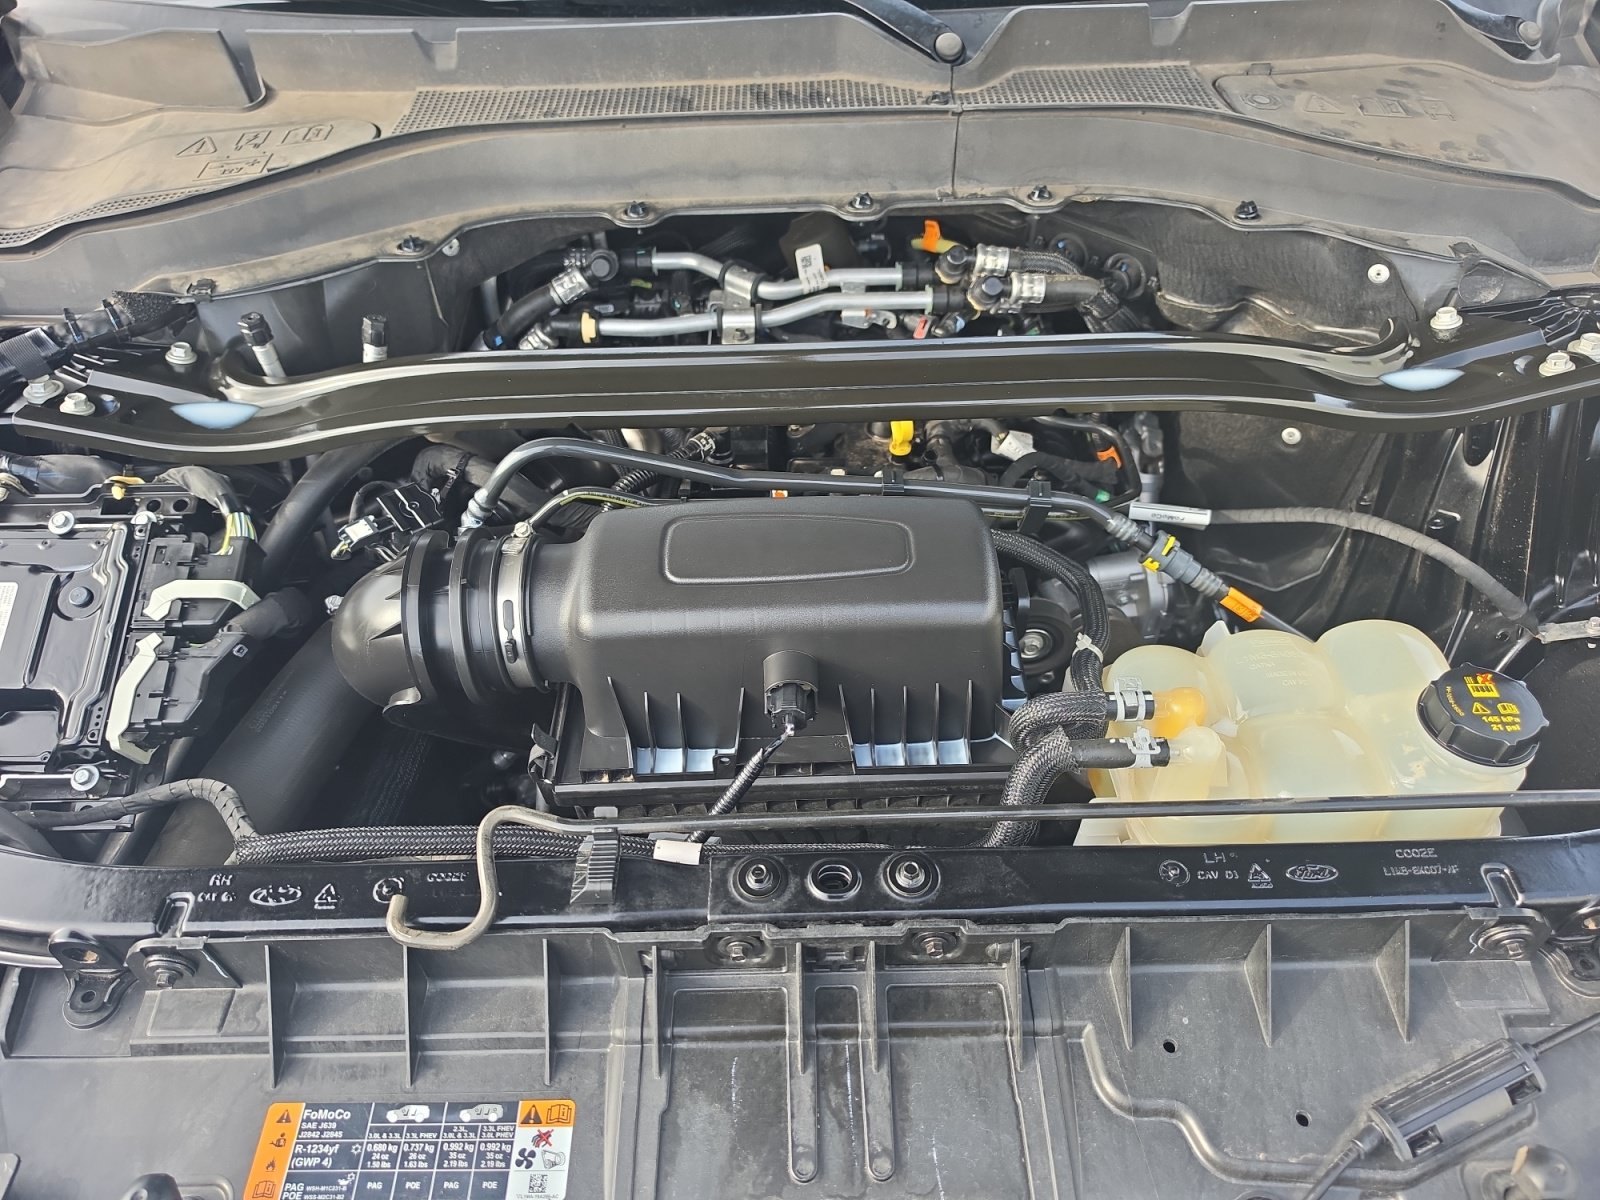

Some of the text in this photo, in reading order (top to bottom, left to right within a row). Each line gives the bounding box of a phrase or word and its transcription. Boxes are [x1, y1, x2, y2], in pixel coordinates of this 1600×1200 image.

[1505, 724, 1520, 732] psi
[1197, 870, 1219, 880] CAV
[303, 1109, 351, 1120] FoMoCo
[294, 1144, 340, 1155] R-1234yf
[366, 1143, 398, 1153] 0.680 kg
[403, 1143, 435, 1153] 0.737 kg
[443, 1143, 474, 1152] 0.992 kg
[480, 1143, 511, 1152] 0.992 kg
[291, 1157, 333, 1169] (GWP 4)
[480, 1160, 506, 1168] 2.19 lbs
[284, 1183, 305, 1191] PAG
[366, 1181, 383, 1189] PAG
[405, 1181, 421, 1189] POE
[443, 1181, 459, 1189] PAG
[282, 1191, 303, 1200] POE
